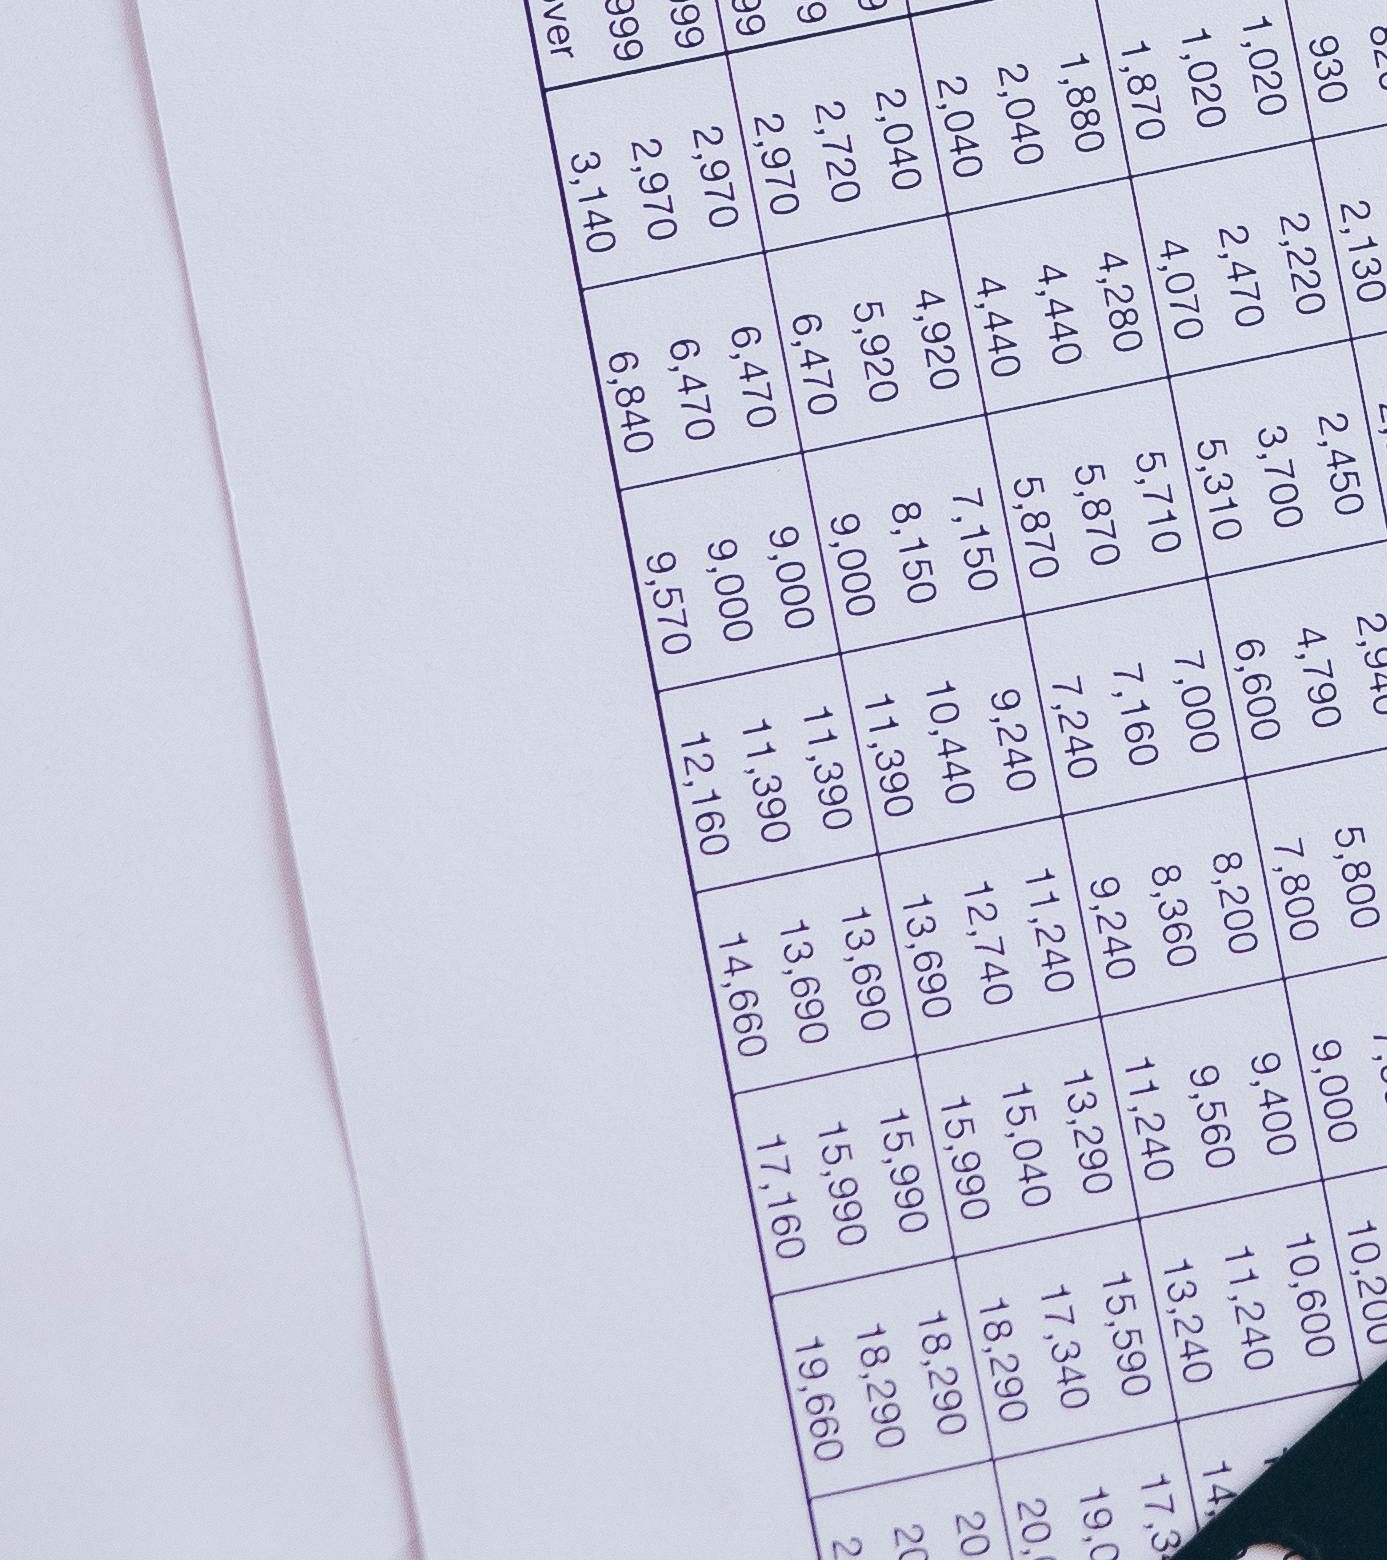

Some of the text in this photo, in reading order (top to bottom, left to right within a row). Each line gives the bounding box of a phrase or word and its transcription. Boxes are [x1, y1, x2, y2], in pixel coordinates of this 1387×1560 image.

[605, 350, 655, 454] 6,840
[643, 551, 693, 656] 9,570
[794, 1335, 845, 1462] 19,660
